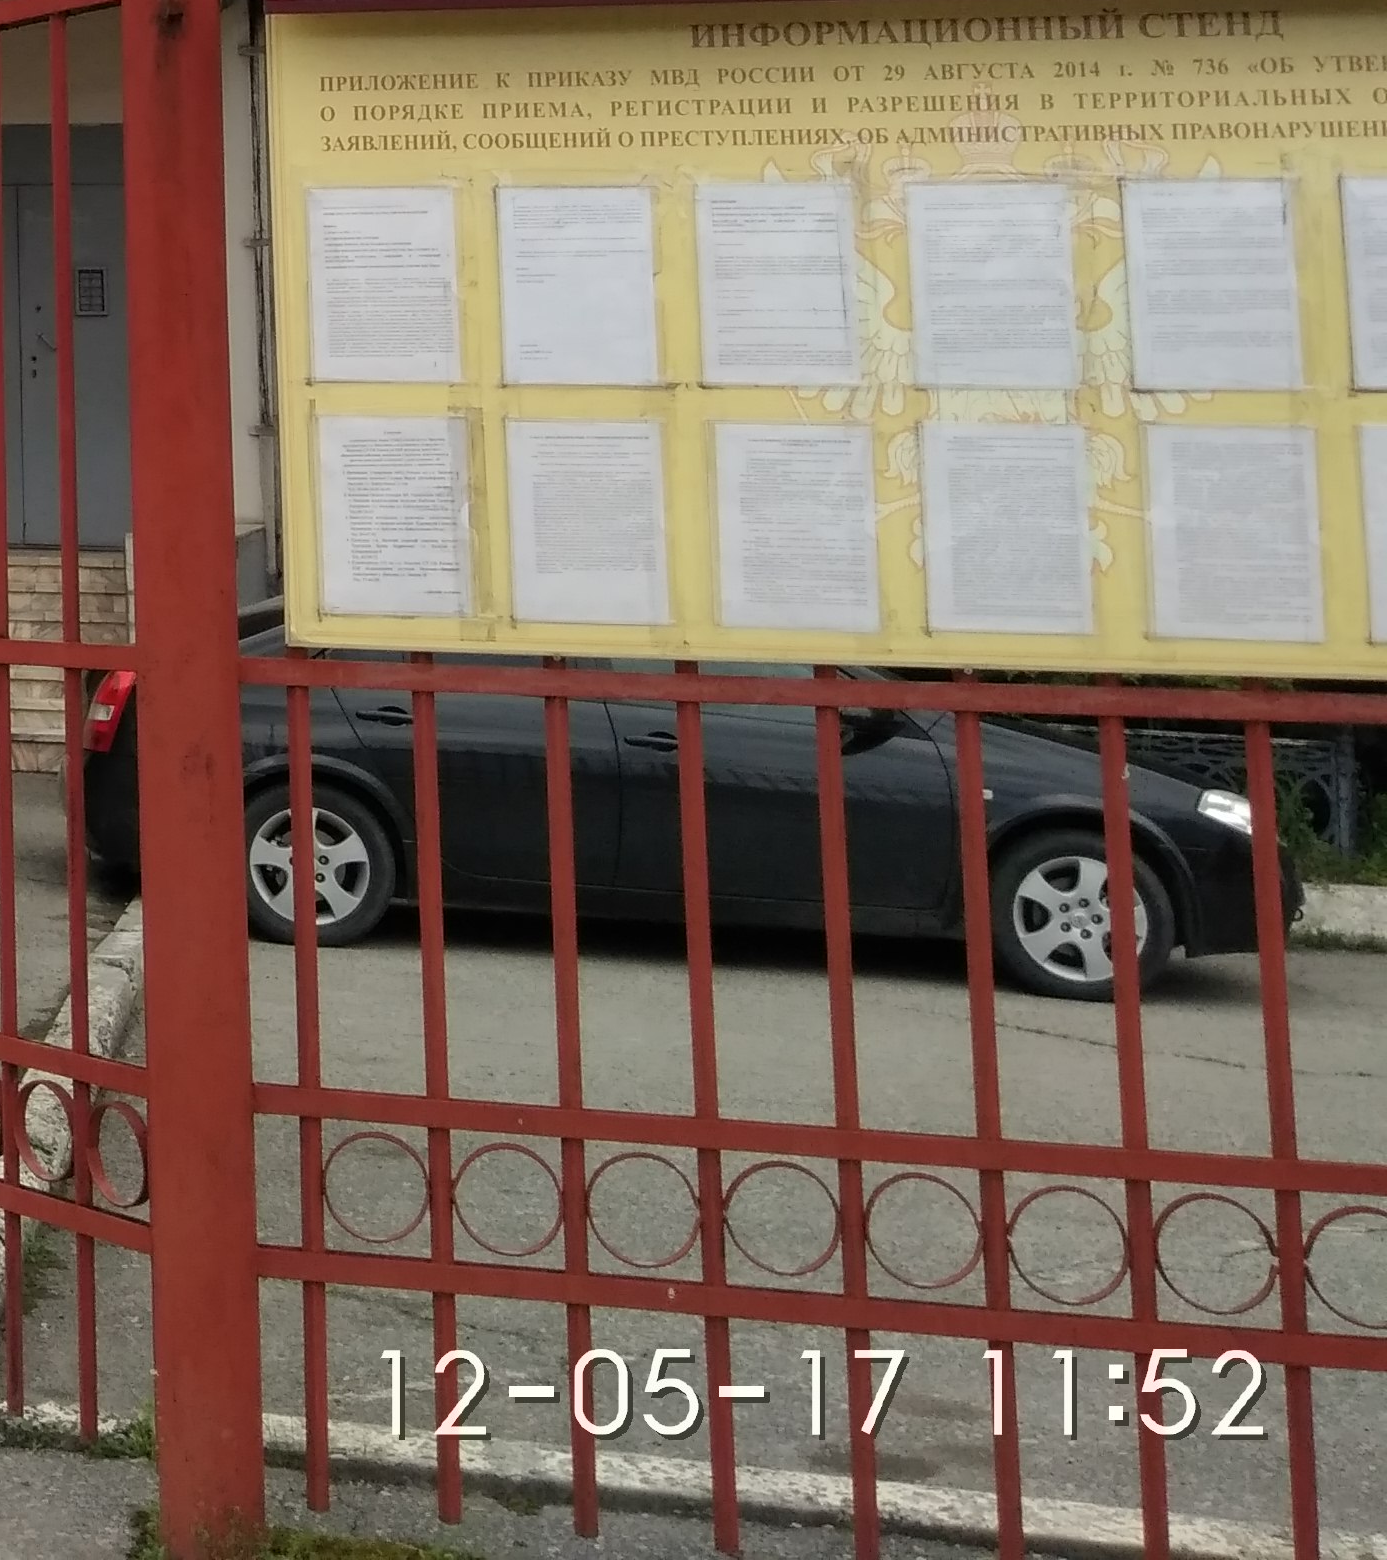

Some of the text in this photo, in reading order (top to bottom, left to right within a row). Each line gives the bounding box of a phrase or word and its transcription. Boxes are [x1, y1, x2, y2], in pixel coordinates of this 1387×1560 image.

[690, 12, 1284, 48] ИНФОРМАЦИОННЫЙ СТЕНД
[319, 71, 478, 92] ПРИЛОЖЕНИЕ
[496, 70, 509, 89] К
[527, 68, 631, 88] ПРИКАЗУ
[650, 67, 699, 89] МВД
[717, 65, 813, 84] РОССИИ
[833, 64, 864, 82] ОТ
[883, 63, 905, 81] 29
[925, 61, 1033, 81] АВГУСТА
[1151, 58, 1173, 77] №
[1192, 57, 1228, 76] 736
[1248, 56, 1293, 75] «ОБ
[319, 85, 1387, 125] О ПОРЯДКЕ ПРИЕМА, РЕГИСТРАЦИИ И РАЗРЕШЕНИЯ В ТЕРРИТОРИАЛЬНЫХ О
[321, 128, 457, 155] ЗАЯВЛЕНИЙ,
[462, 126, 610, 153] СООБЩЕНИЙ
[617, 129, 633, 147] О
[641, 126, 854, 150] ПРЕСТУПЛЕНИЯХ,
[853, 125, 888, 144] ОБ
[896, 121, 1163, 147] АДМИНИСТРАТИВНЫХ
